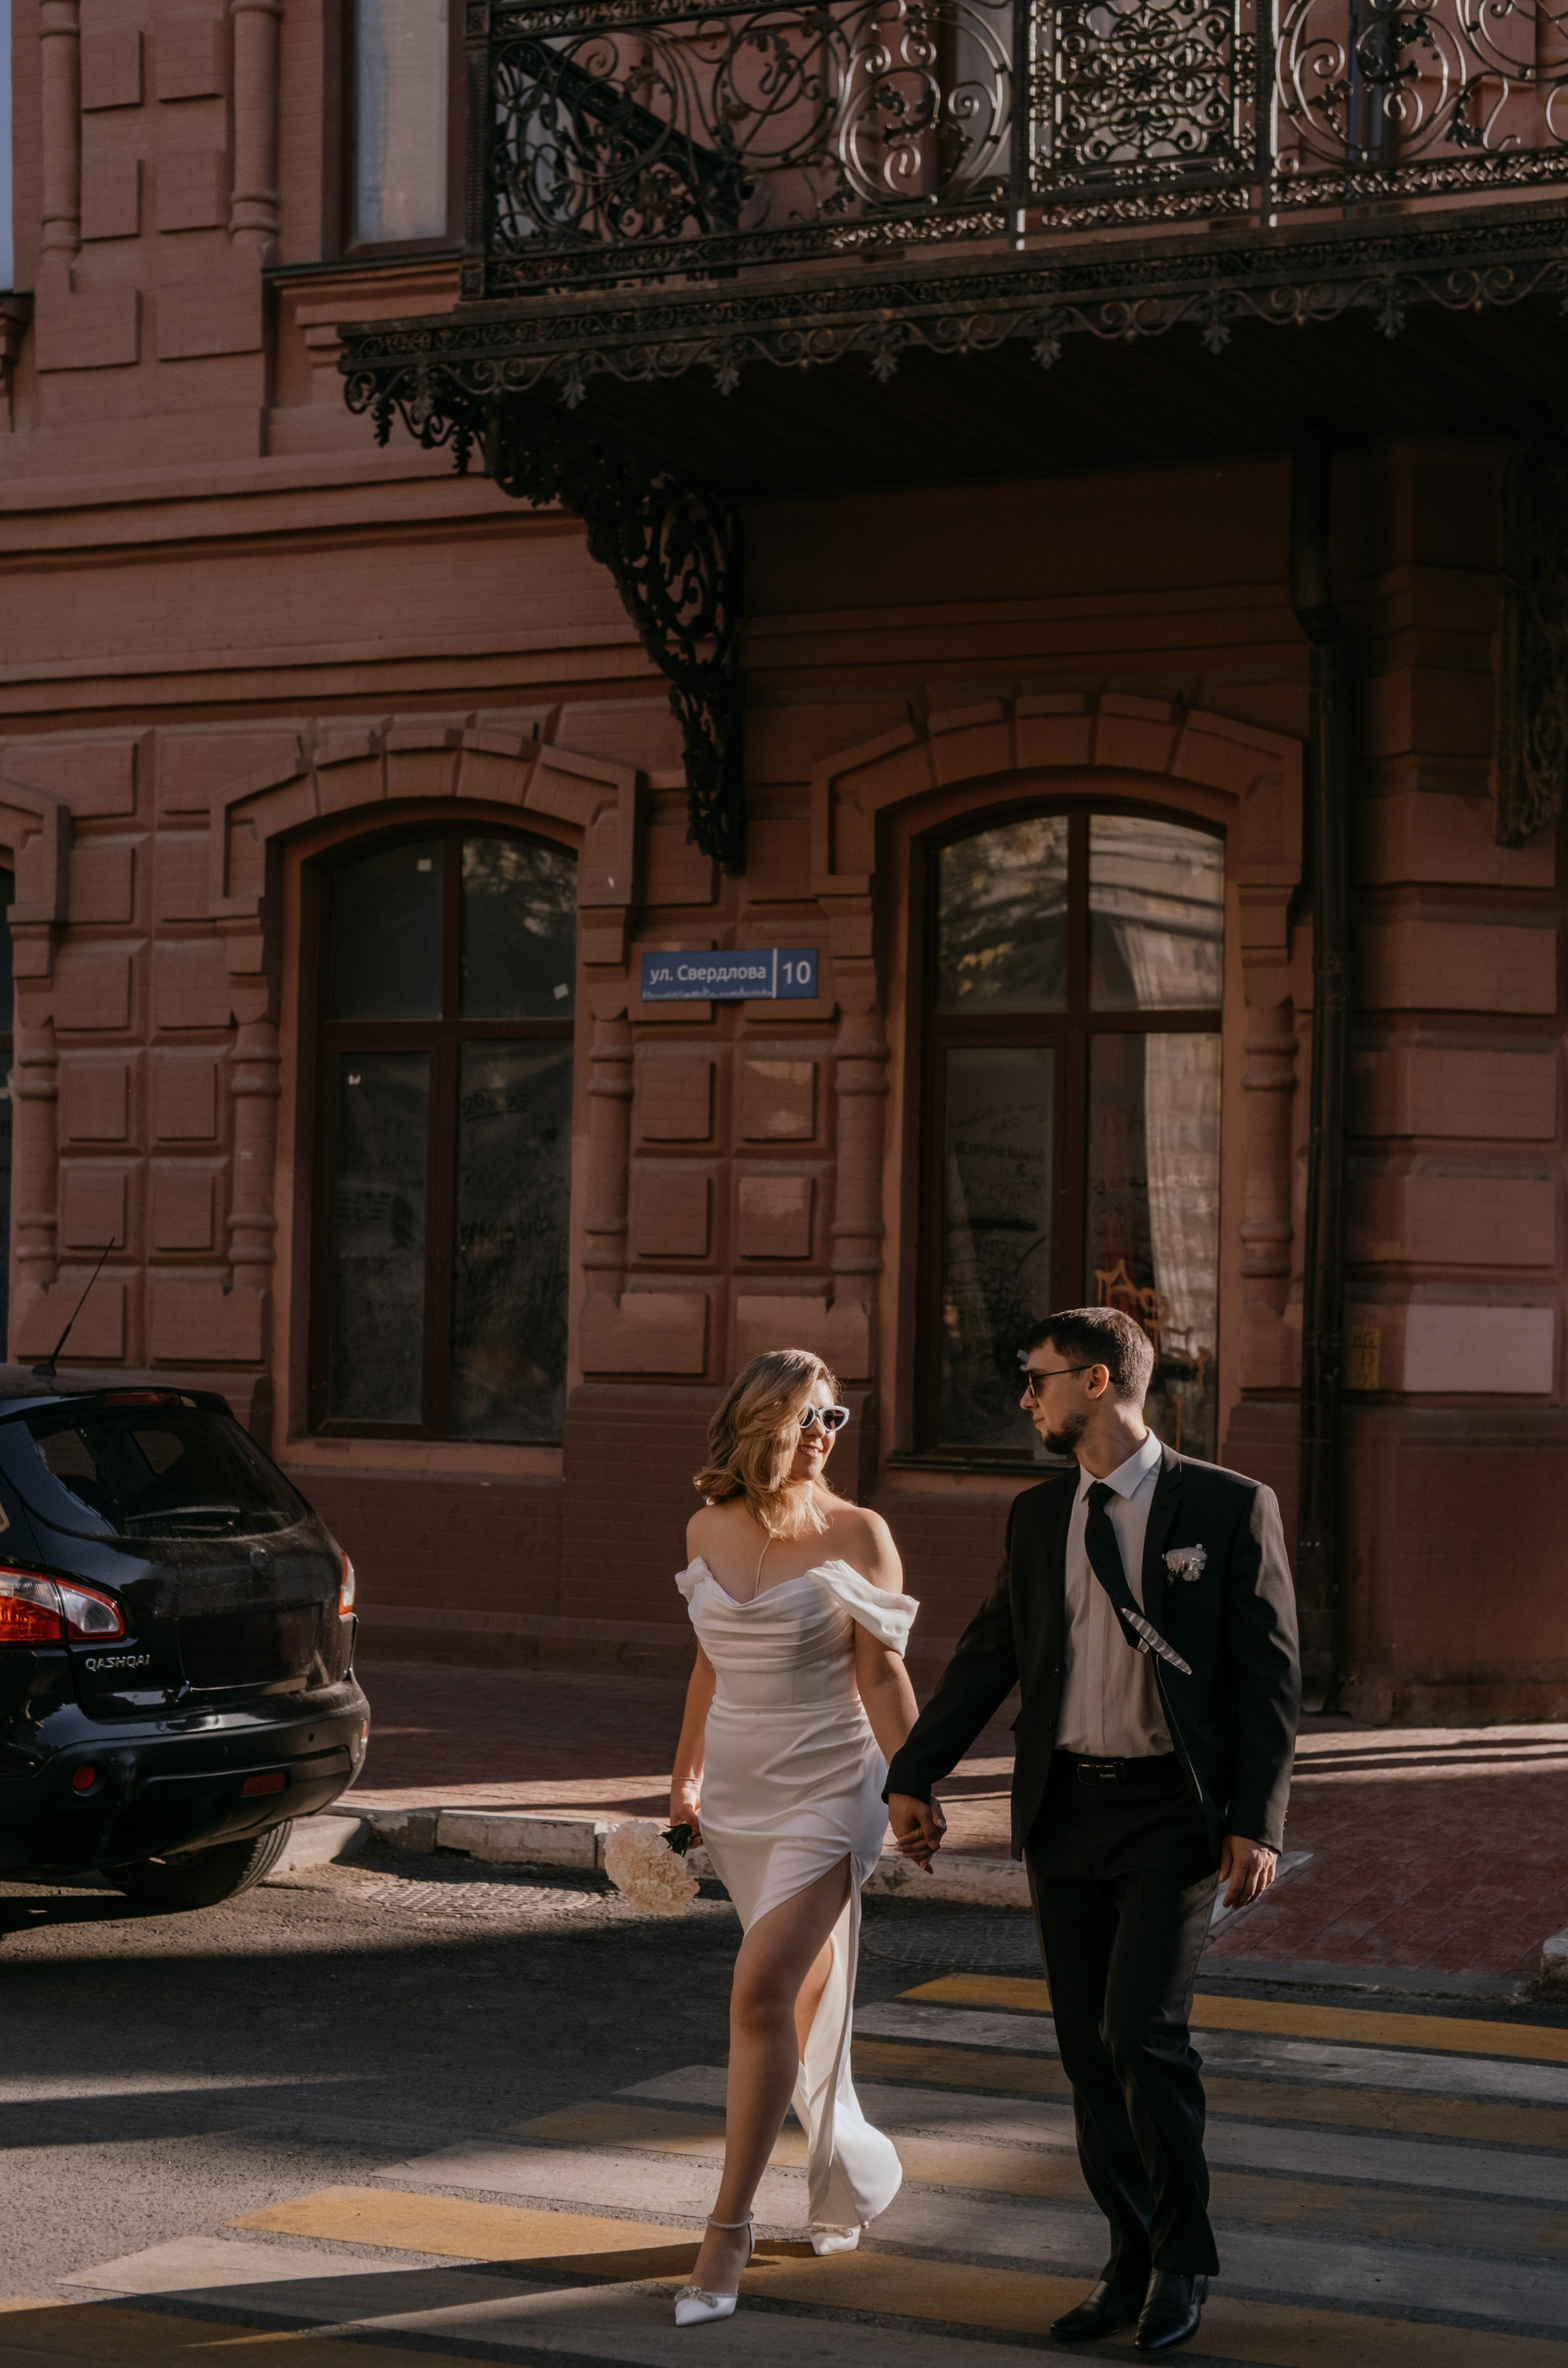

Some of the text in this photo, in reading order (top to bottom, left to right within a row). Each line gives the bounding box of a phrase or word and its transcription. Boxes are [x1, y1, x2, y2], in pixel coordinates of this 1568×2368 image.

[650, 965, 766, 985] ул. Свердлова
[783, 961, 811, 984] 10
[86, 1654, 150, 1672] QASHQAI
